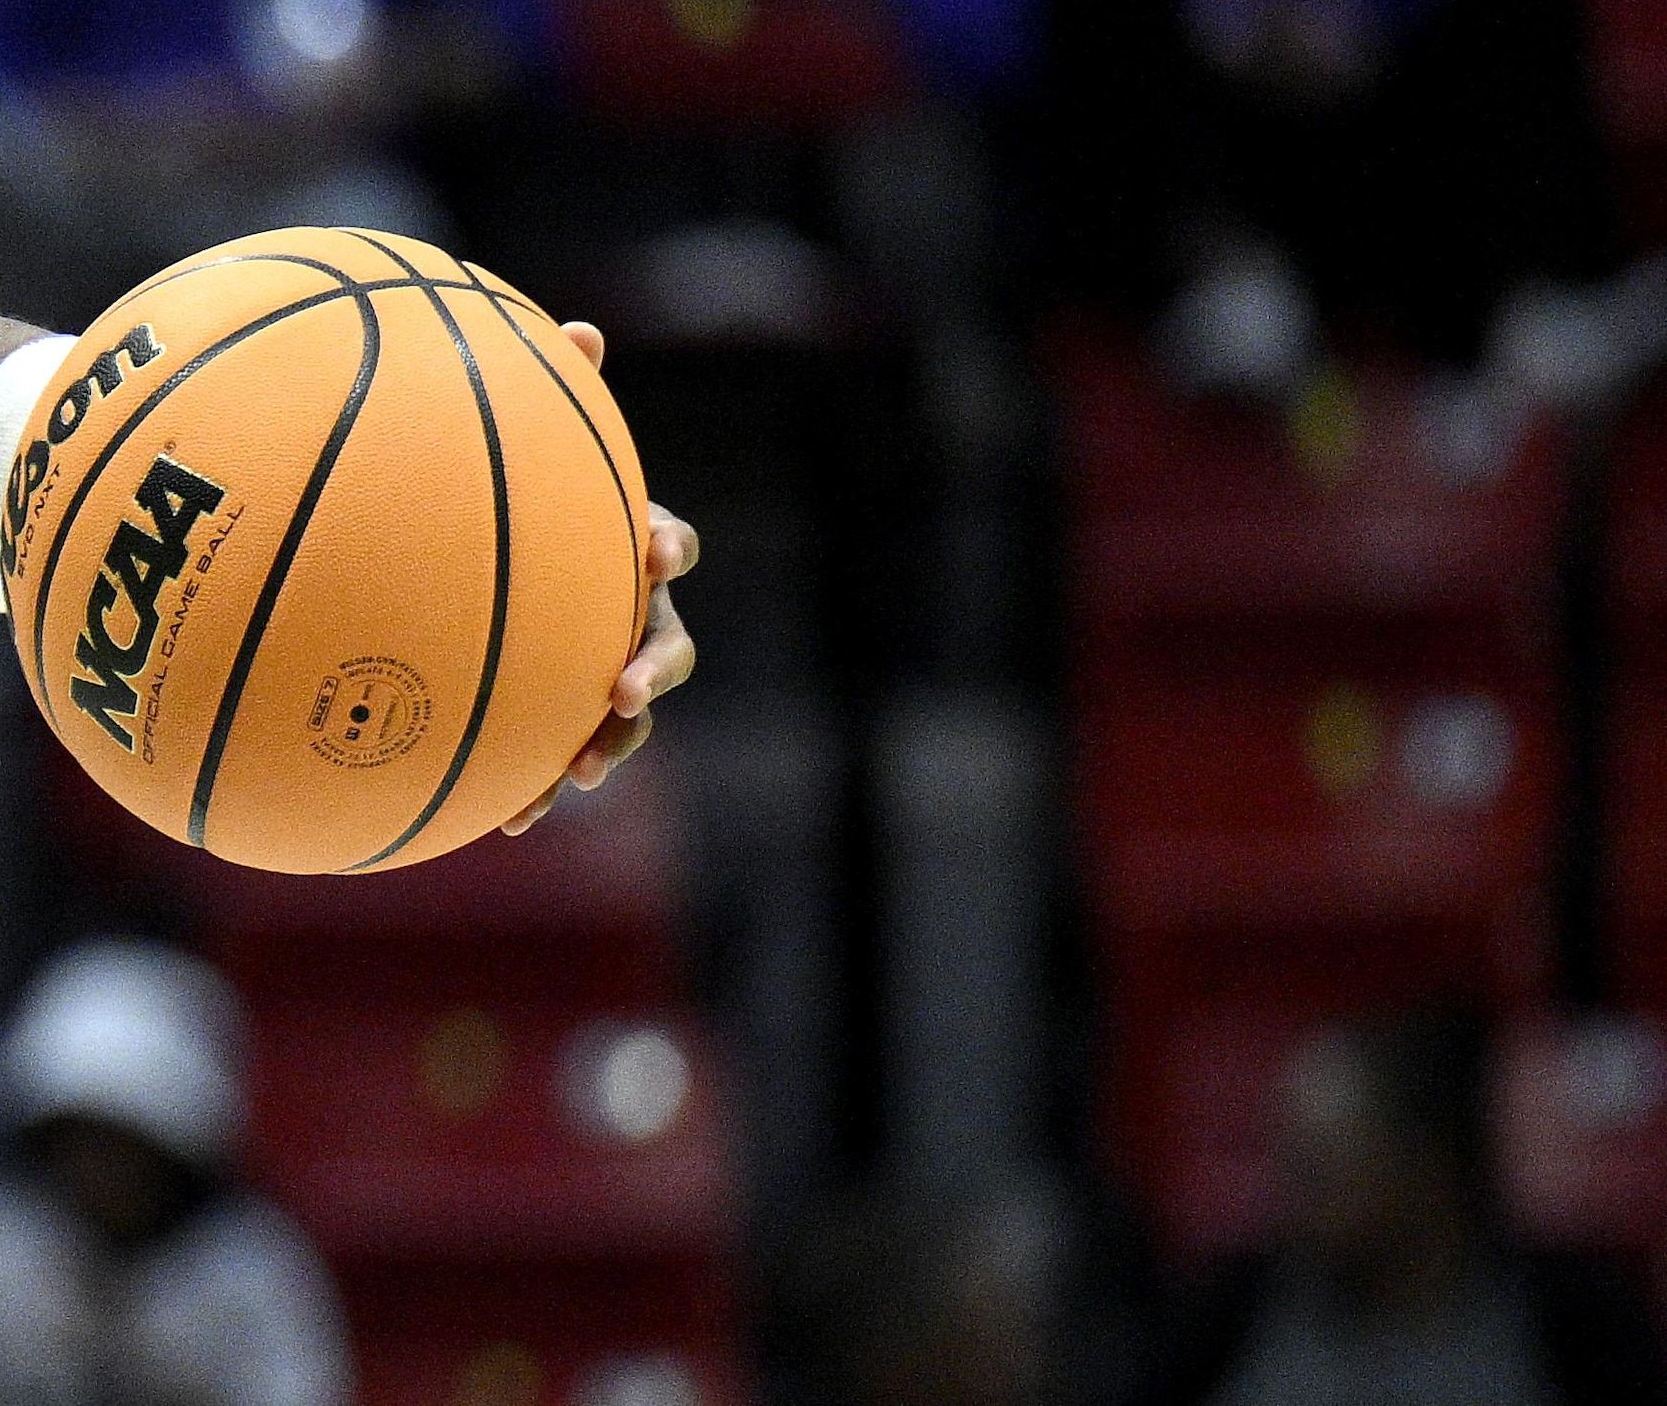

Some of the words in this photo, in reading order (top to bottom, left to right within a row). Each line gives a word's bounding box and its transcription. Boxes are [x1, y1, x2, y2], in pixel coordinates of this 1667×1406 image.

[0, 322, 165, 578] ilson
[34, 463, 61, 519] NXT
[68, 451, 226, 755] NCAA
[141, 665, 169, 765] OFFICIAL
[160, 578, 201, 659] GAME
[195, 505, 245, 575] BALL
[311, 695, 330, 726] SIZE
[324, 680, 334, 690] 7
